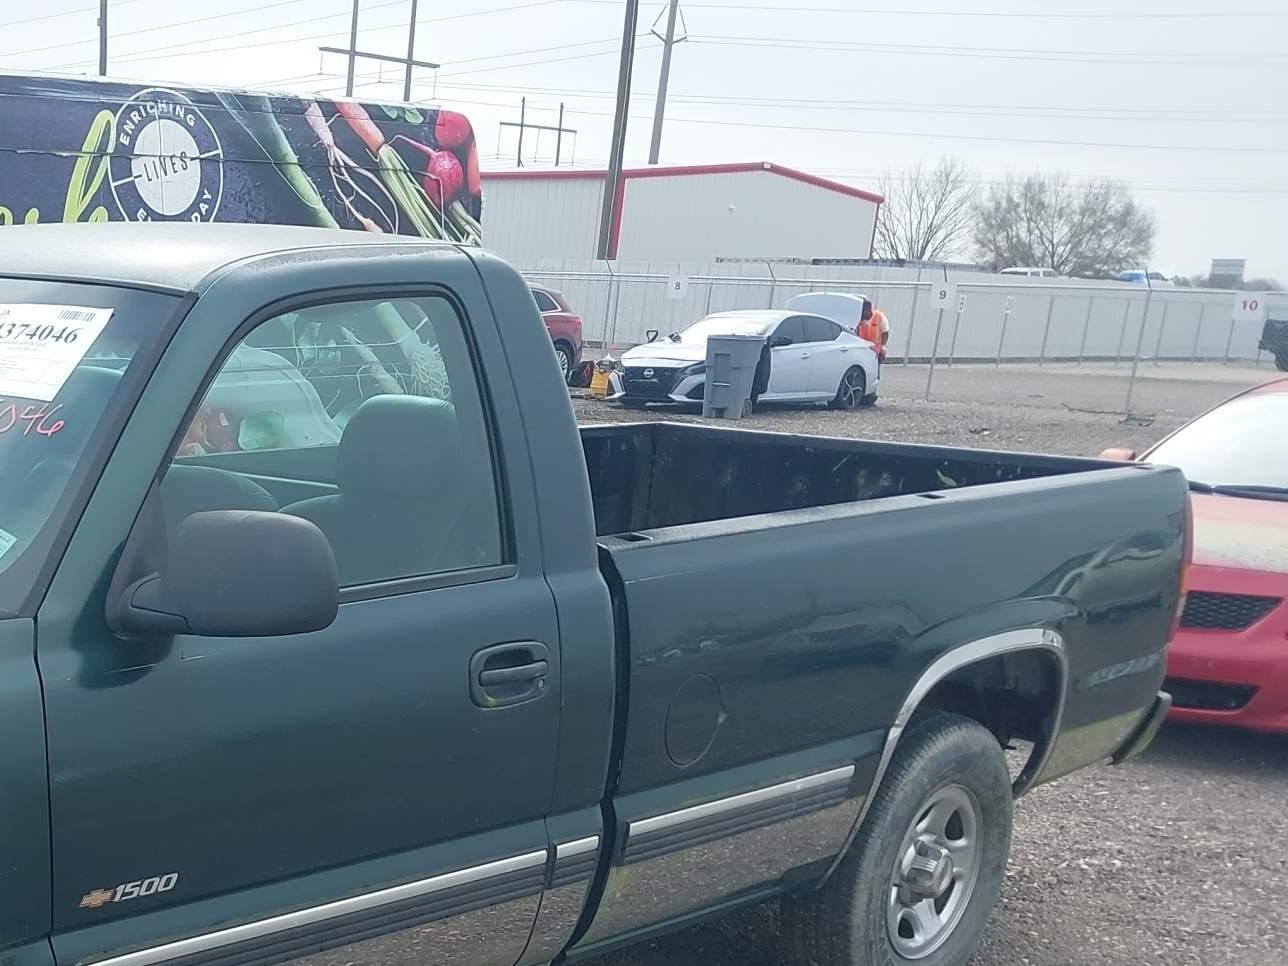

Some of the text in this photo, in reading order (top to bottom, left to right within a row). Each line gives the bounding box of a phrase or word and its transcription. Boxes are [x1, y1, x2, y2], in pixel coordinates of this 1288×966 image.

[119, 100, 196, 146] ENRICHING
[143, 151, 189, 182] LIVES
[939, 289, 947, 300] 9
[1241, 299, 1258, 311] 10
[113, 872, 179, 903] 1500
